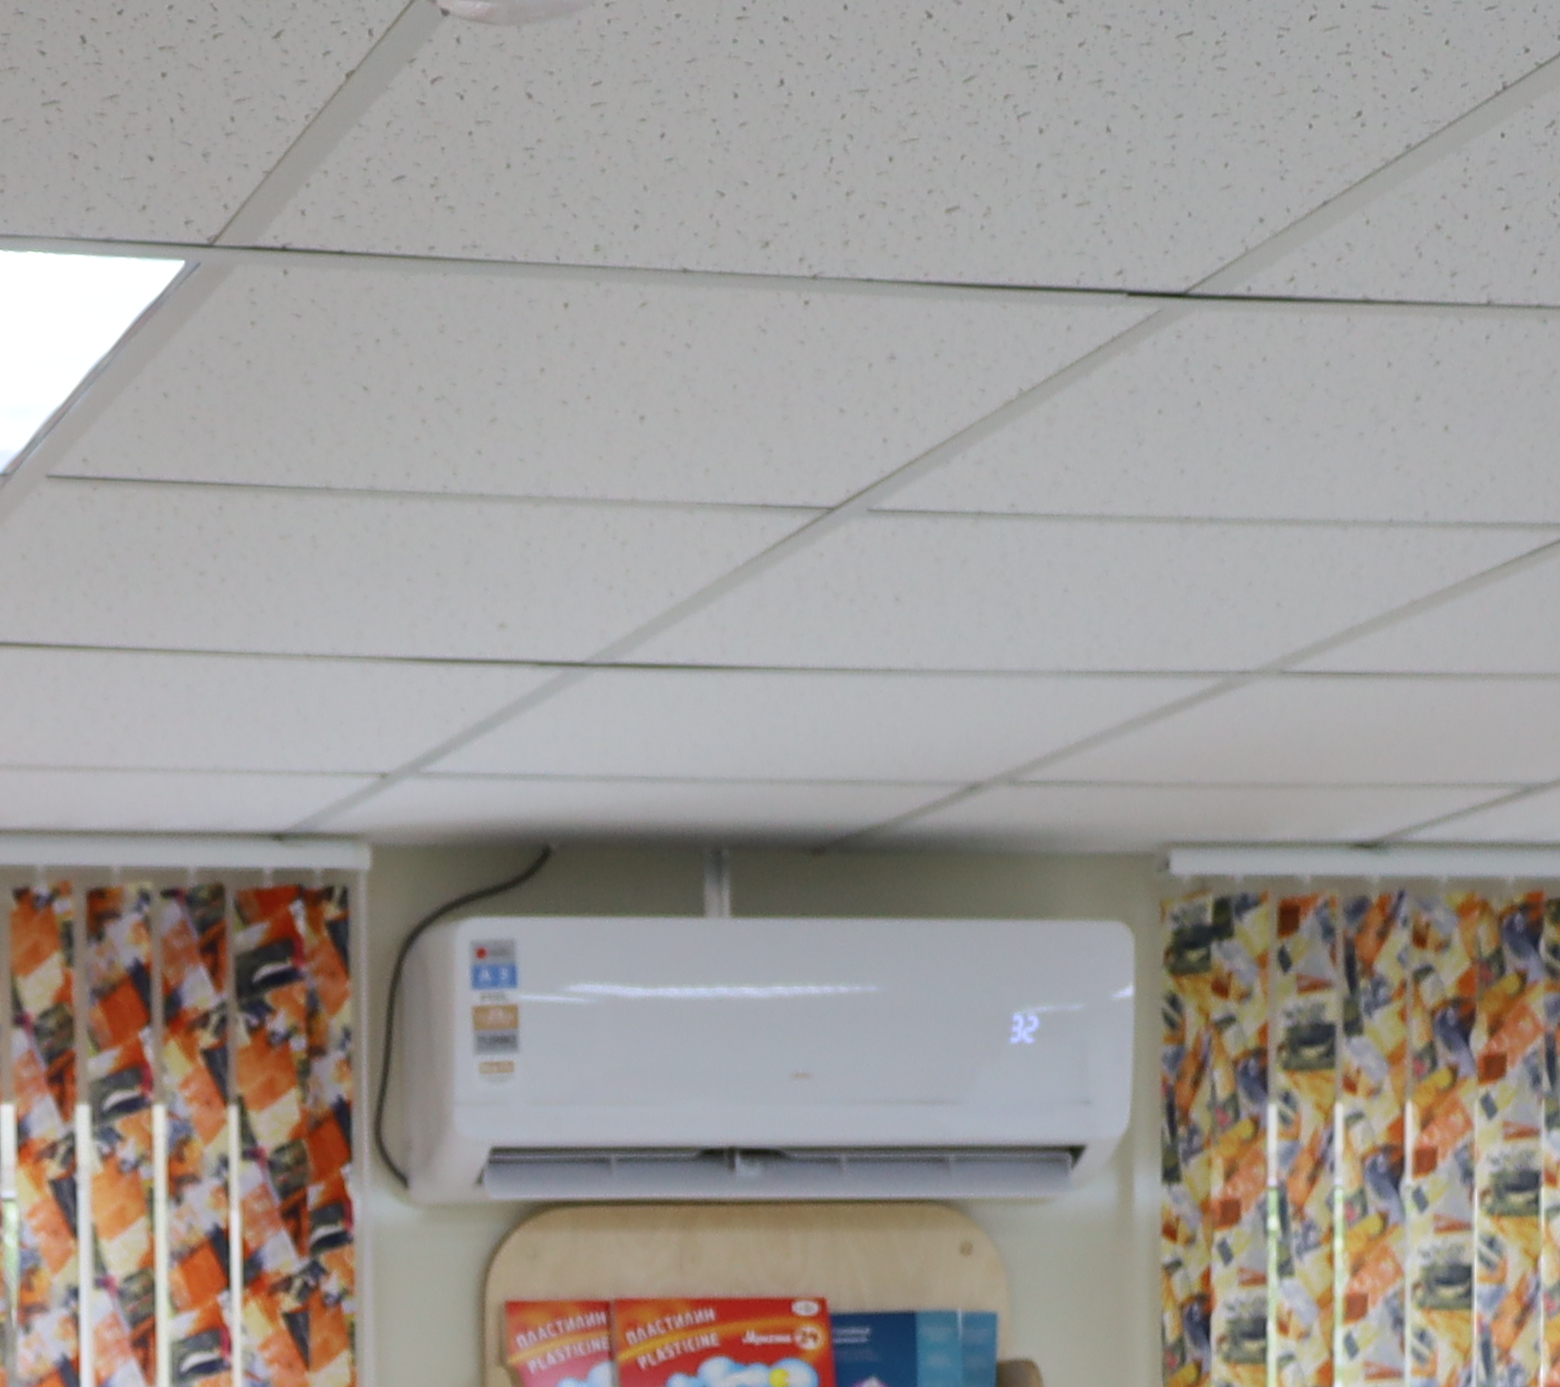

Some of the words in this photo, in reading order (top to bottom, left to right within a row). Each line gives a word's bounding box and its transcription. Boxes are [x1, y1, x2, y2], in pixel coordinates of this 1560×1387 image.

[1010, 1014, 1039, 1044] 32
[516, 1311, 608, 1349] ПЛАСТИЛИН
[625, 1307, 718, 1346] ПЛАСТИЛИН
[526, 1335, 611, 1374] PLASTICINE
[637, 1332, 721, 1370] PLASTICINE
